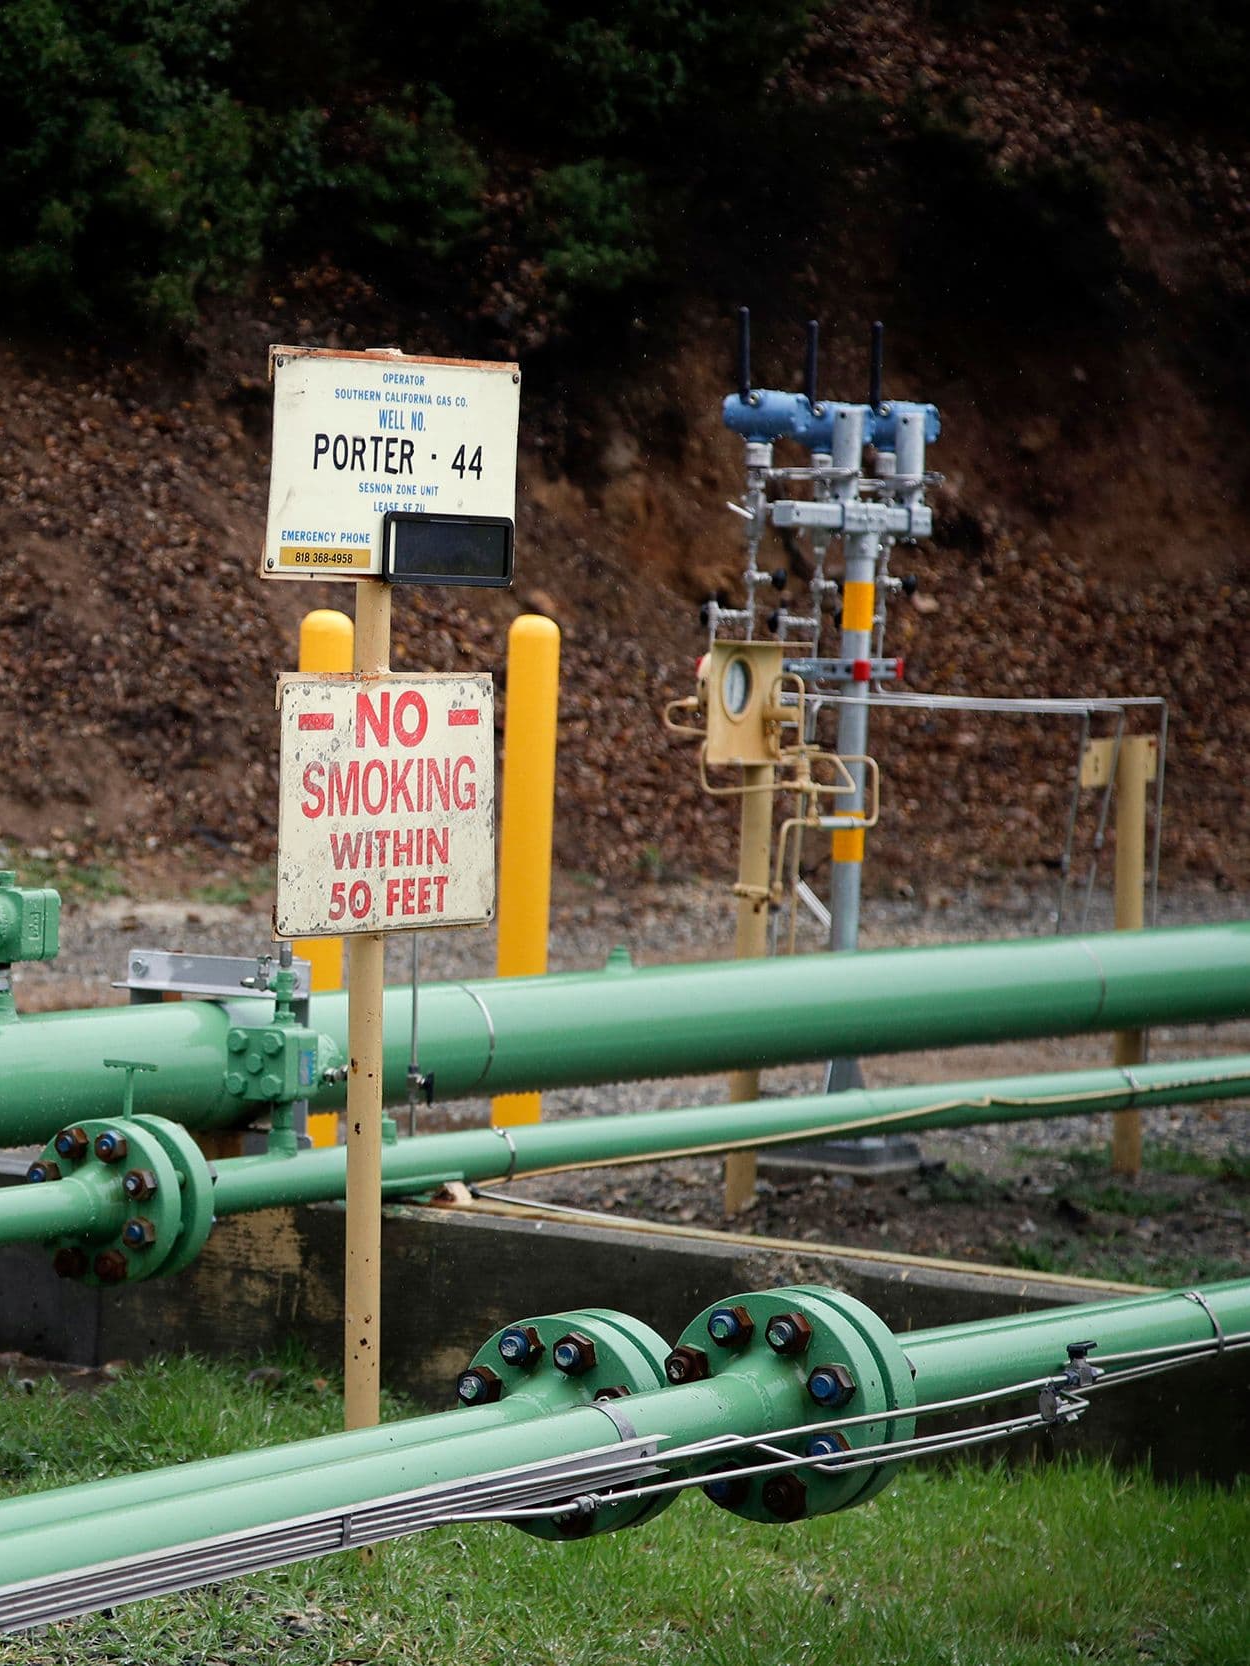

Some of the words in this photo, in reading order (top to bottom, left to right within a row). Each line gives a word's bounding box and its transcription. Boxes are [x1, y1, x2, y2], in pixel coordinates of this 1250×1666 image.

[382, 373, 425, 386] OPERATOR
[334, 388, 381, 402] SOUTHERN
[385, 391, 432, 406] CALIFORNIA
[436, 395, 452, 407] GAS
[455, 397, 468, 408] CO.
[379, 409, 405, 430] WELL
[411, 411, 426, 432] NO.
[313, 433, 415, 475] PORTER
[451, 444, 483, 481] 44
[358, 482, 392, 494] SESNON
[396, 484, 417, 495] ZONE
[420, 485, 439, 497] UNIT
[373, 501, 399, 512] LEASE
[281, 530, 336, 542] EMERGENCY
[340, 532, 370, 544] PHONE
[295, 552, 310, 563] 818
[312, 552, 353, 564] 368-4958
[355, 690, 428, 748] NO
[301, 755, 476, 819] SMOKING
[330, 827, 449, 870] WITHIN
[328, 879, 372, 921] 50
[386, 876, 449, 917] FEET
